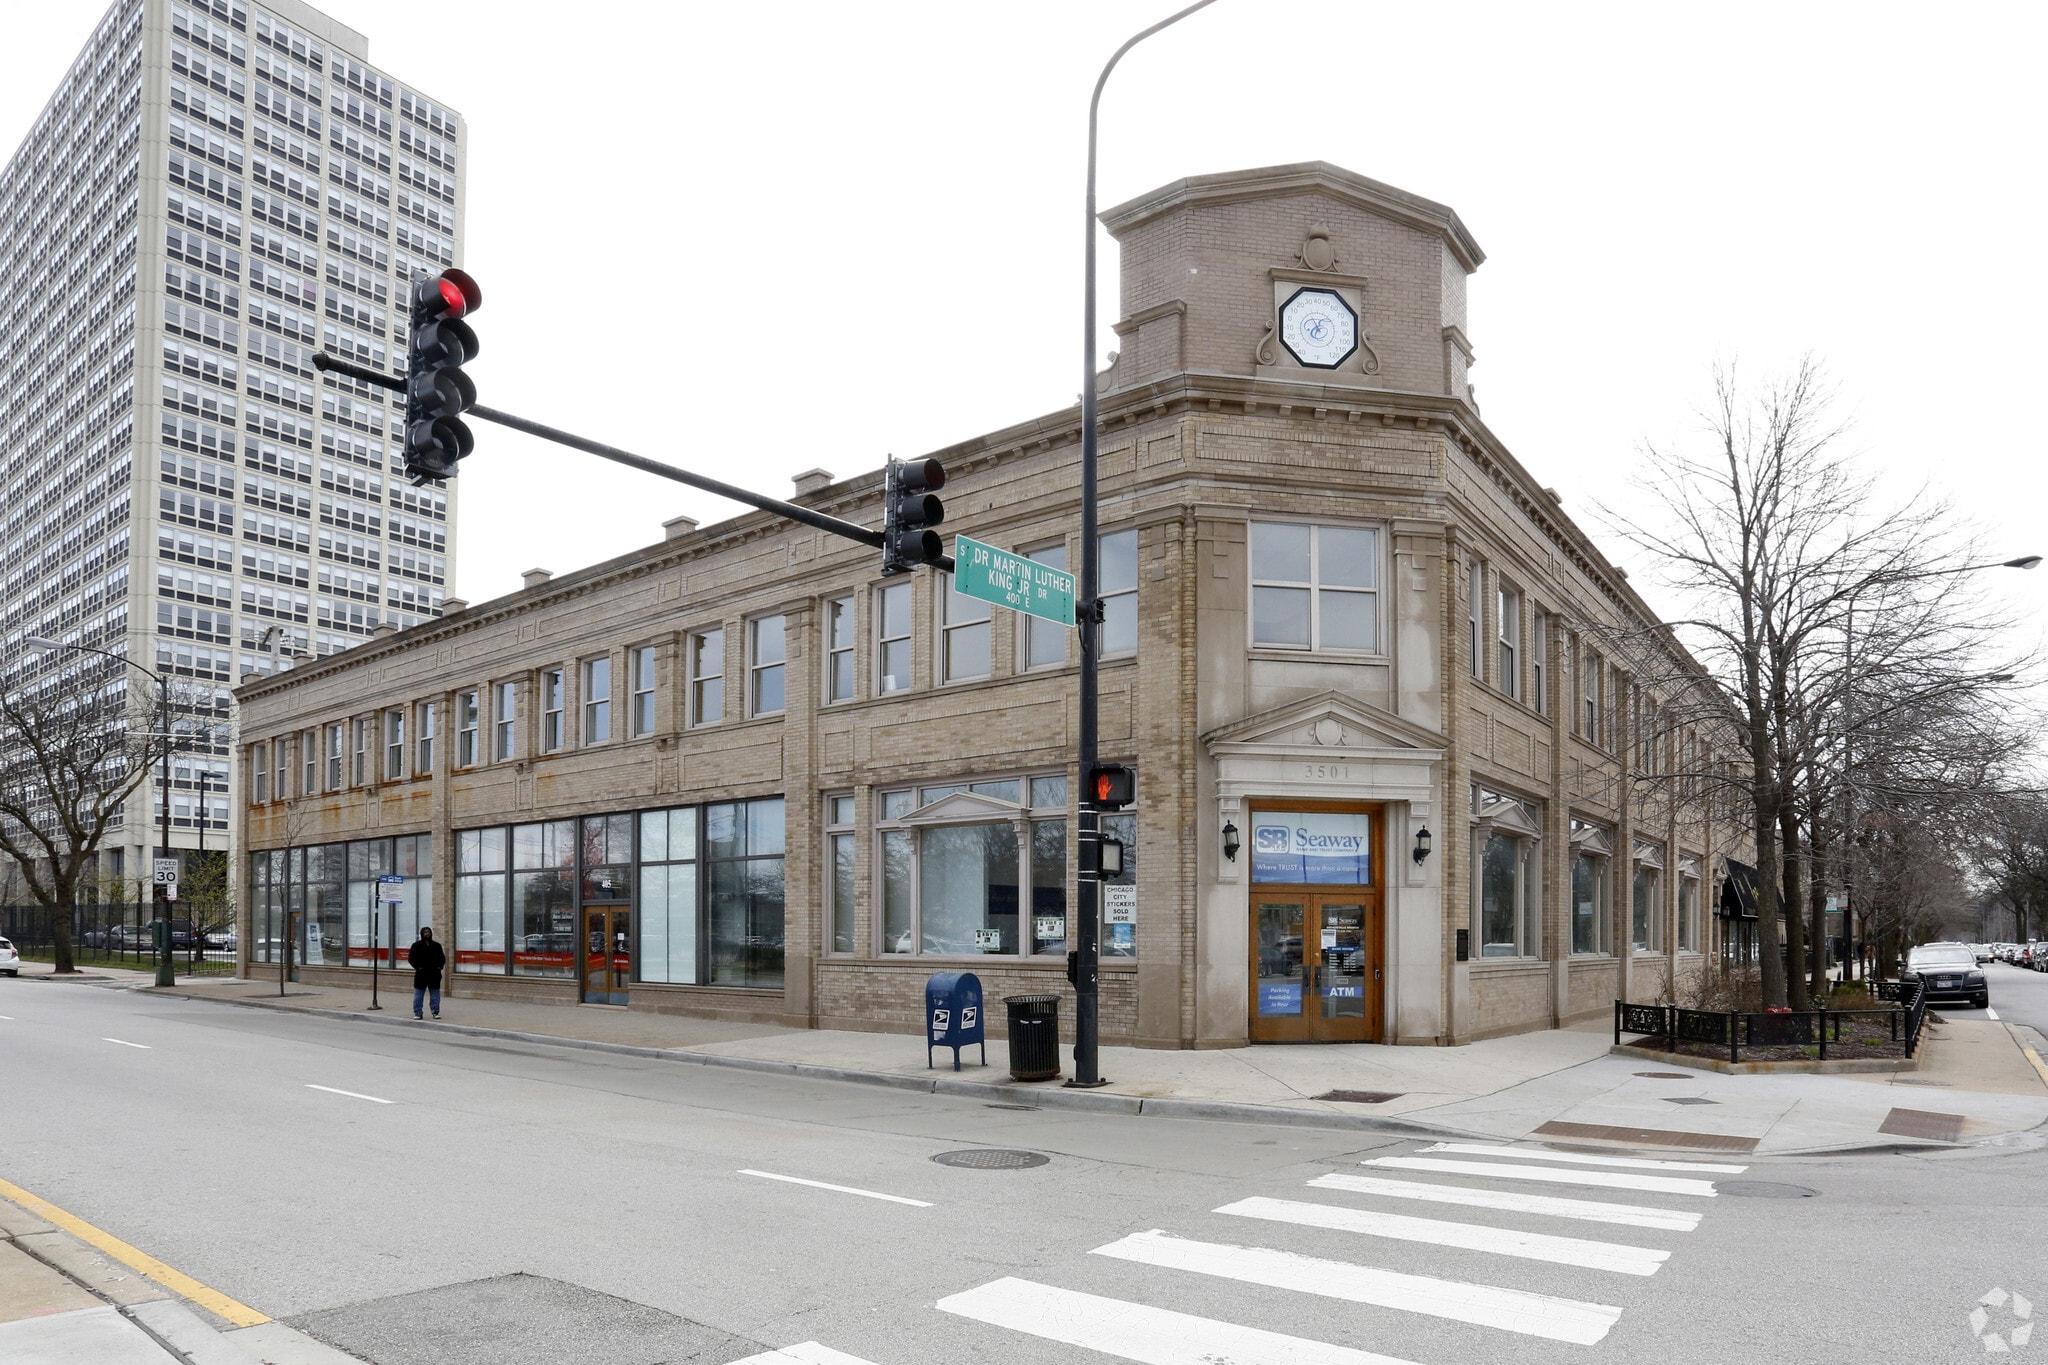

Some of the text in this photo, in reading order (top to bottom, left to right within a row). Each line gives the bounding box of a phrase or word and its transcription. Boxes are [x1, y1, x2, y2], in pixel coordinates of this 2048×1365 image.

[960, 545, 1072, 594] S DR MARTIN LUTHER
[988, 568, 1048, 600] KING JR DR
[1005, 591, 1030, 608] 400 E
[1304, 764, 1350, 779] 3501
[1295, 827, 1364, 852] Seaway
[1256, 863, 1277, 871] Where
[156, 871, 176, 882] 30
[1329, 987, 1355, 997] ATM
